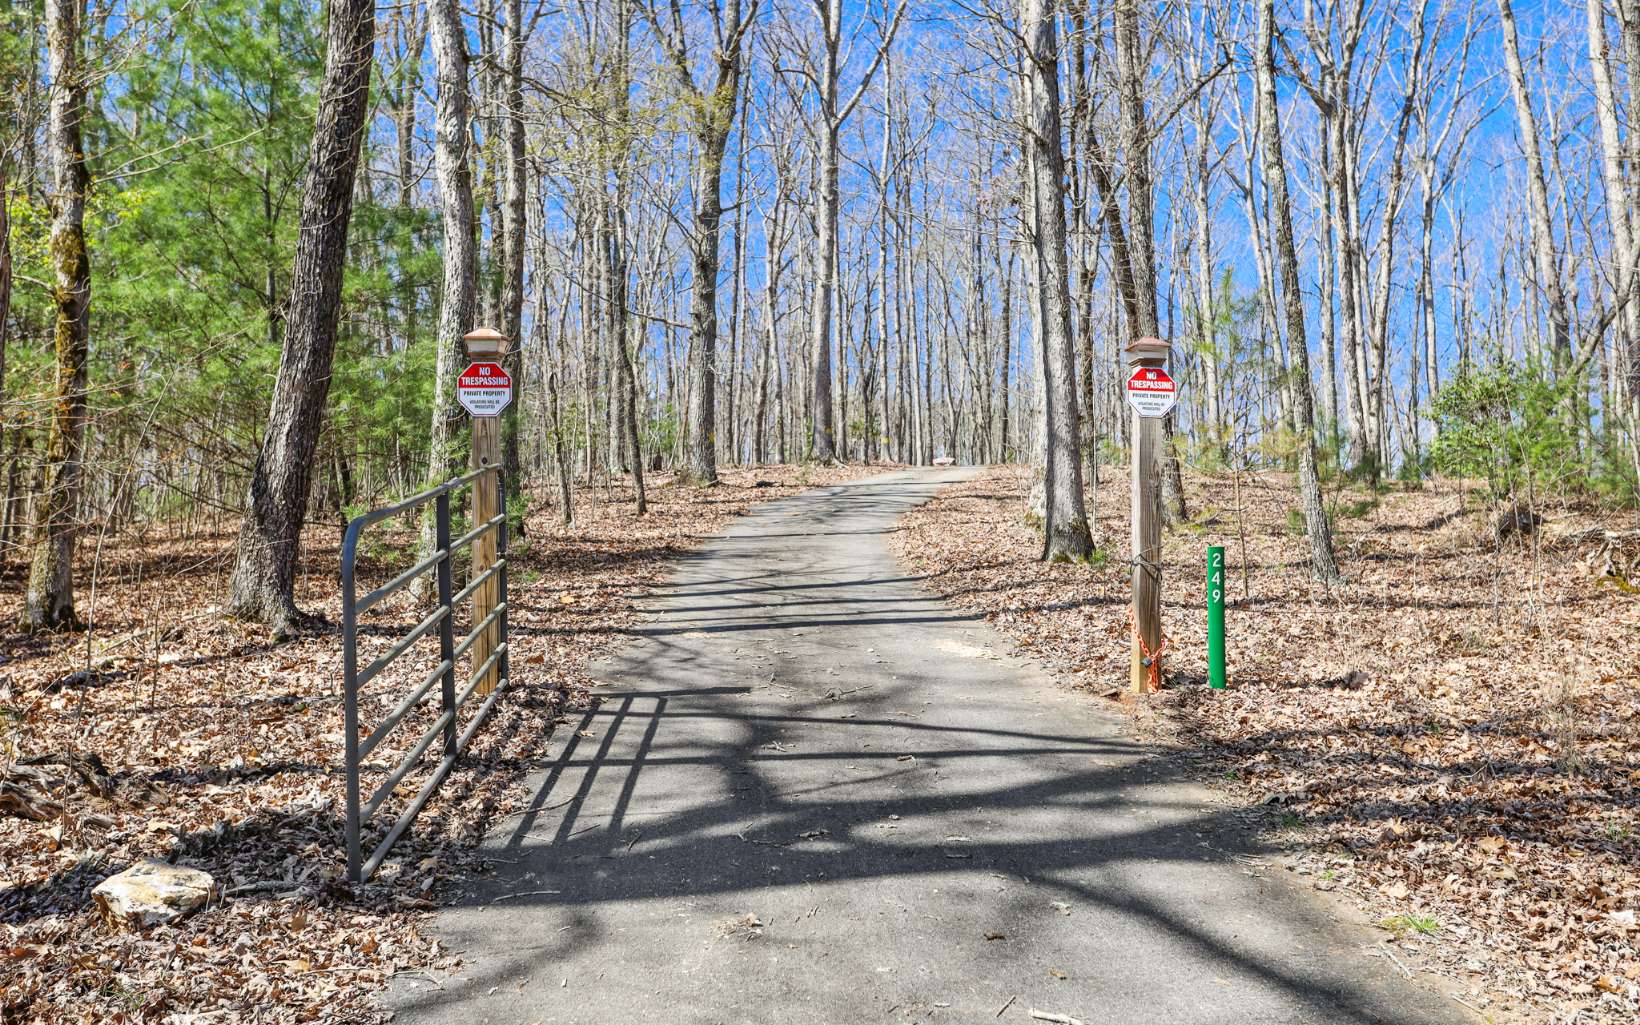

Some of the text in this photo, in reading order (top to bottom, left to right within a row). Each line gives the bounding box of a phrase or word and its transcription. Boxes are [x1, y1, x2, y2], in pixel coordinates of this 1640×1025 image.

[479, 367, 491, 376] NO
[1146, 371, 1157, 380] NO
[461, 377, 508, 386] TRESPASSING
[1131, 380, 1172, 389] TRESPASSING
[1211, 552, 1221, 603] 249
